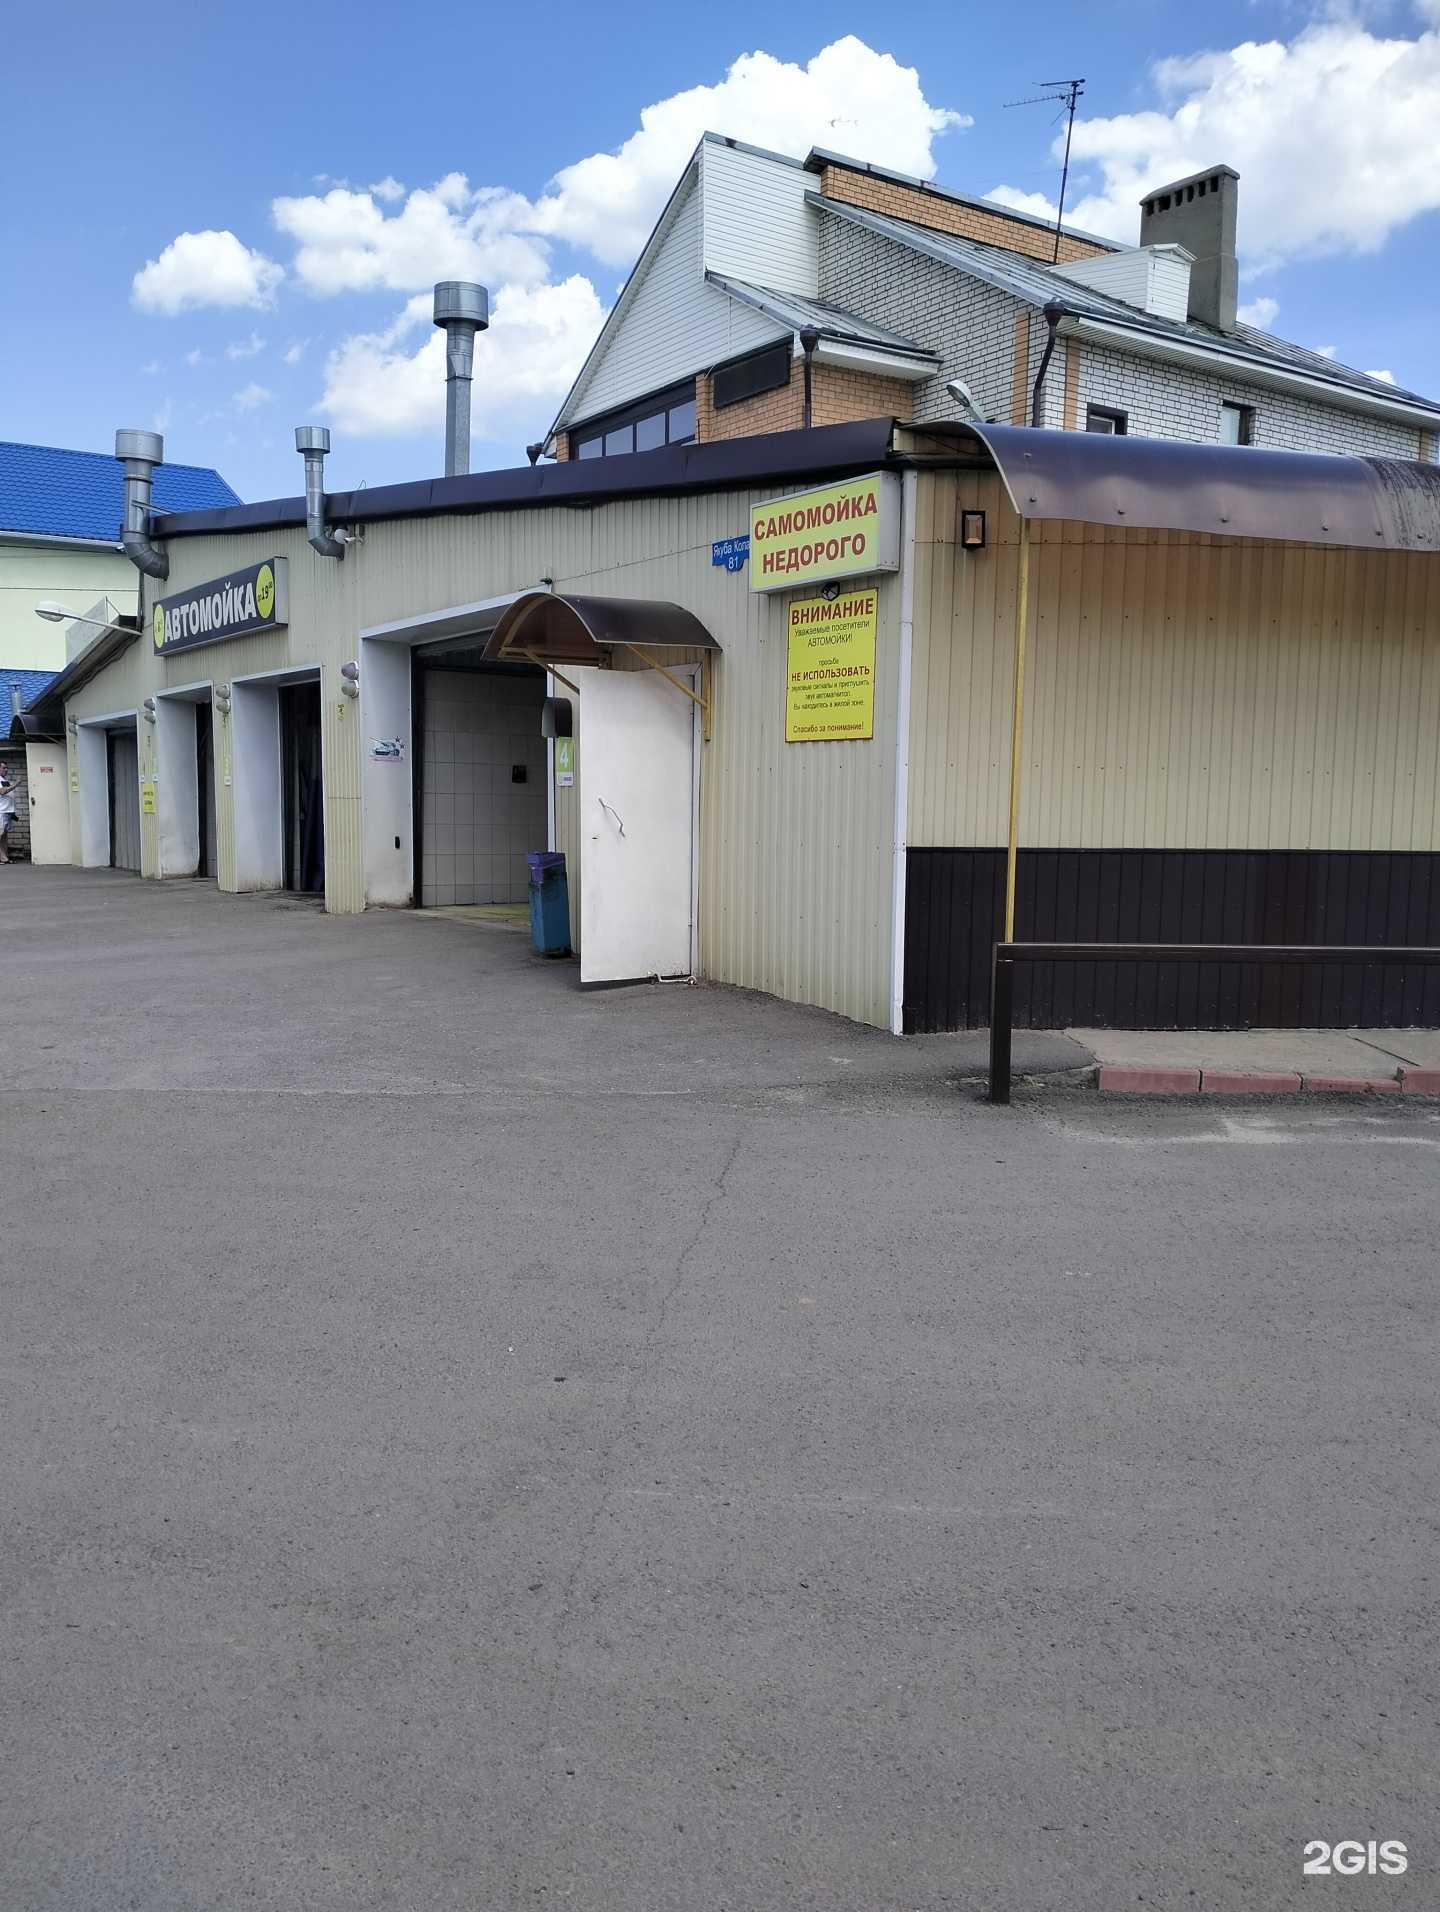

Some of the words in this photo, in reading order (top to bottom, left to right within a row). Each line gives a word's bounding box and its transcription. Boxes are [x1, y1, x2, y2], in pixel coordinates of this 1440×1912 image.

[754, 493, 878, 541] САМОМОЙКА
[728, 556, 738, 569] 81
[762, 533, 866, 573] НЕДОРОГО
[164, 582, 257, 643] АВТОМОЙКА
[792, 597, 874, 625] ВНИМАНИЕ
[795, 625, 830, 637] Уважаемые
[831, 620, 870, 631] посетители
[791, 672, 801, 682] НЕ
[803, 665, 870, 681] ИСПОЛЬЗОВАТЬ
[793, 724, 818, 733] Спасибо
[827, 722, 864, 732] понимание!
[560, 742, 569, 768] 4
